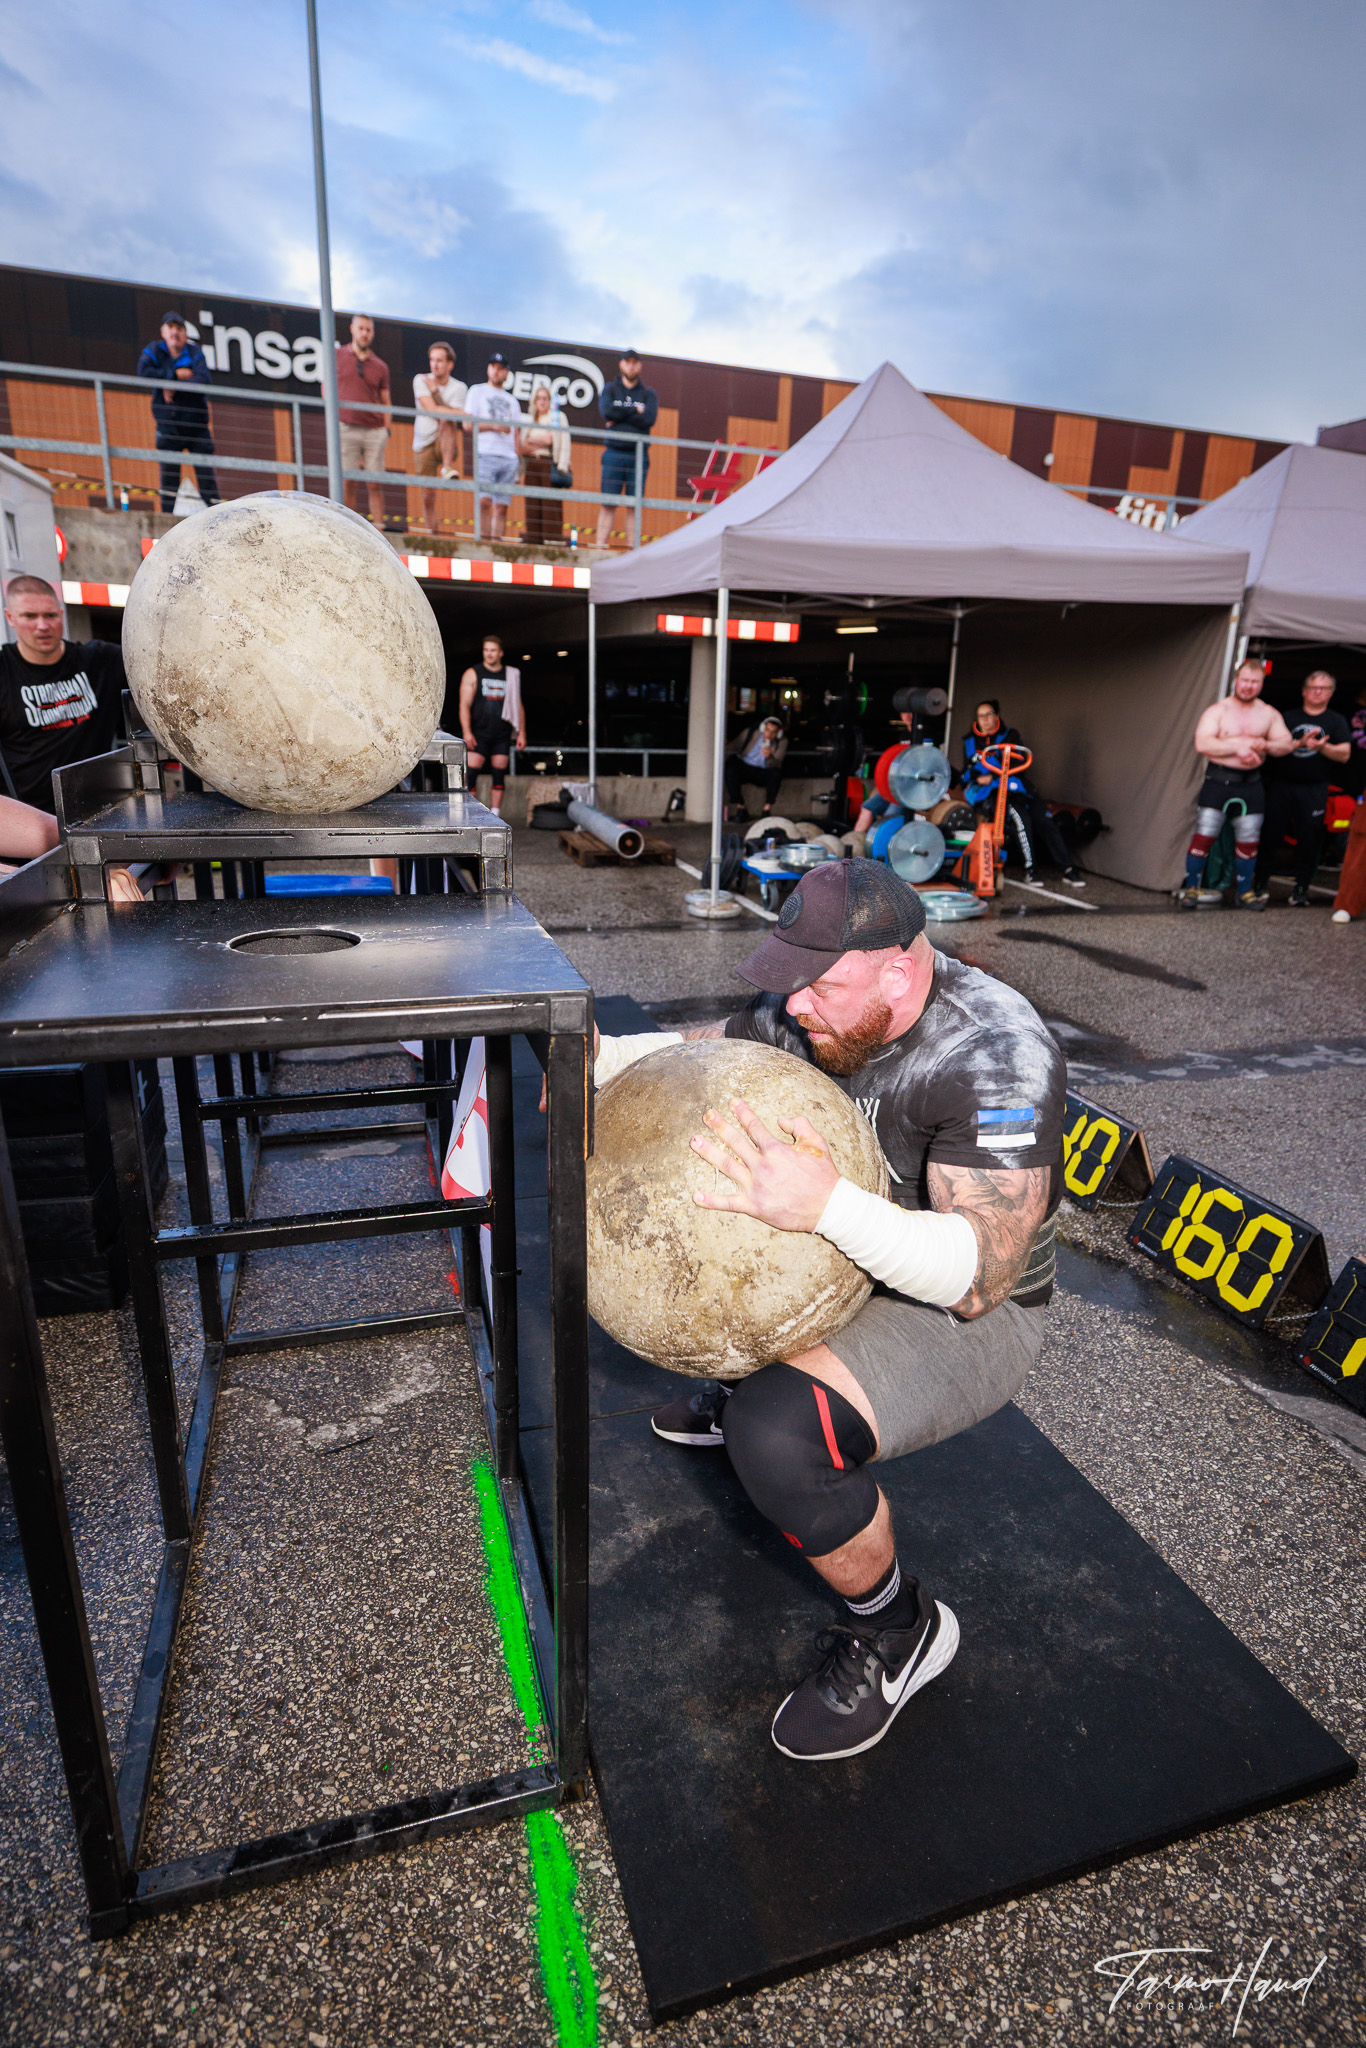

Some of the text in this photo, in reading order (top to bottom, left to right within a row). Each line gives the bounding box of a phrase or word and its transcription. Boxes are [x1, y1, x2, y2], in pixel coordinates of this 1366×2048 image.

[184, 310, 341, 383] insa
[1115, 495, 1187, 533] fitn
[1161, 1180, 1294, 1312] 160
